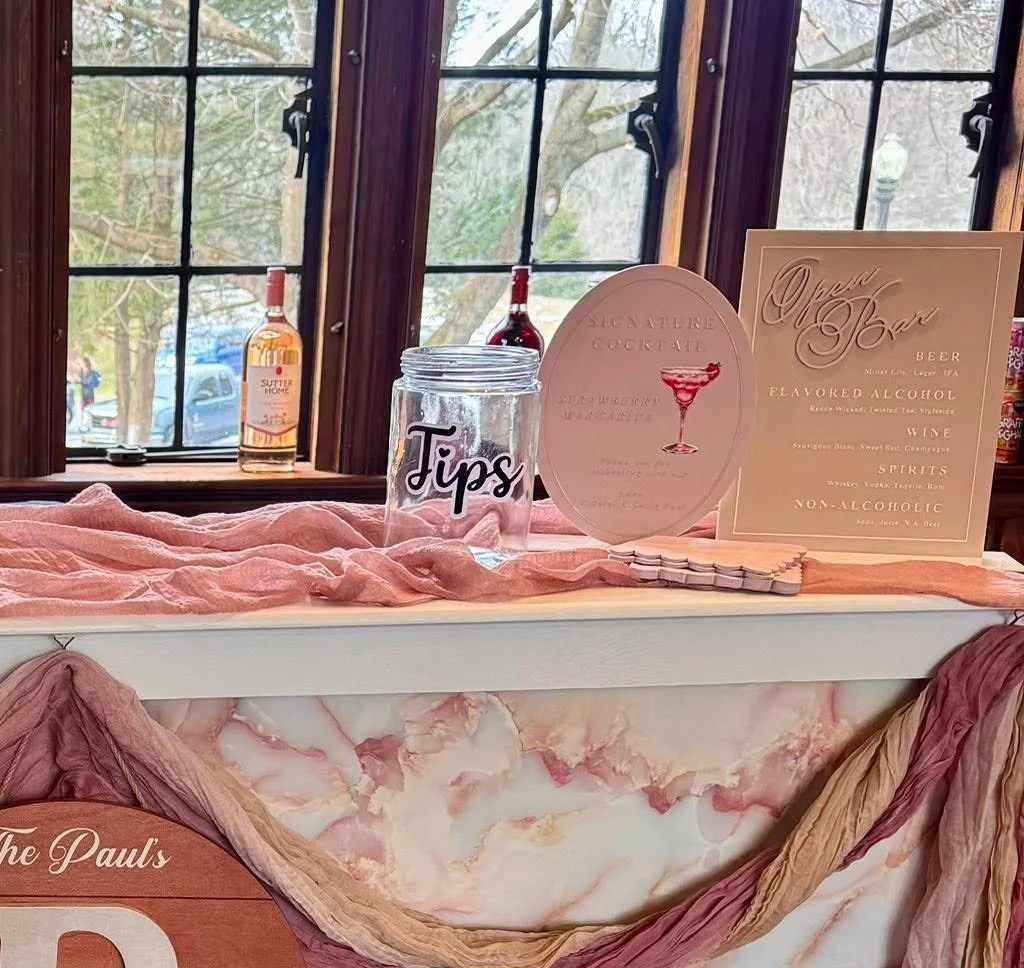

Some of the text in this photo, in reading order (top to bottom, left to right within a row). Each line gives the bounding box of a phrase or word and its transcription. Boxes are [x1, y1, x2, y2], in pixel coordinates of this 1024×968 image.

[761, 255, 881, 330] Open
[586, 316, 715, 331] SIGNATURE
[794, 279, 940, 370] Bar
[592, 337, 706, 352] COCKTAIL
[915, 351, 961, 362] BEER
[260, 378, 293, 387] SUTTER
[264, 387, 290, 395] HOME
[769, 386, 957, 401] FLAVORED ALCOHOL
[906, 427, 952, 439] WINE
[407, 424, 525, 516] Tips
[877, 464, 949, 476] SPIRITS
[793, 498, 944, 514] NON-ALCOHOLIC
[48, 826, 172, 875] Paul's
